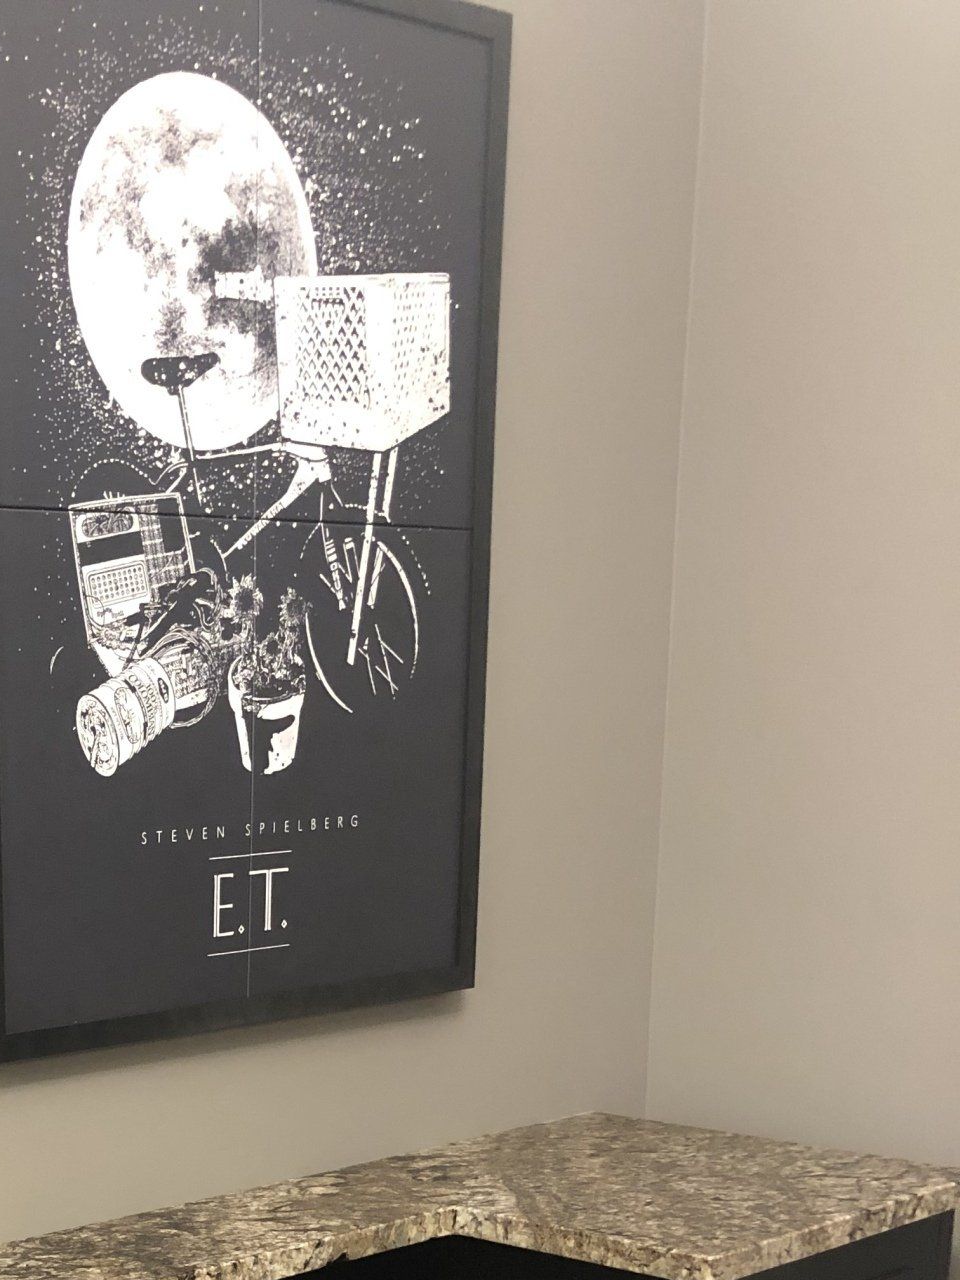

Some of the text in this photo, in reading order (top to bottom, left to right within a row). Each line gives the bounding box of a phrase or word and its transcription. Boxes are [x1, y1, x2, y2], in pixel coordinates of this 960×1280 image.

[141, 814, 359, 845] STEVEN SPIELBERG
[213, 867, 289, 938] E.T.
